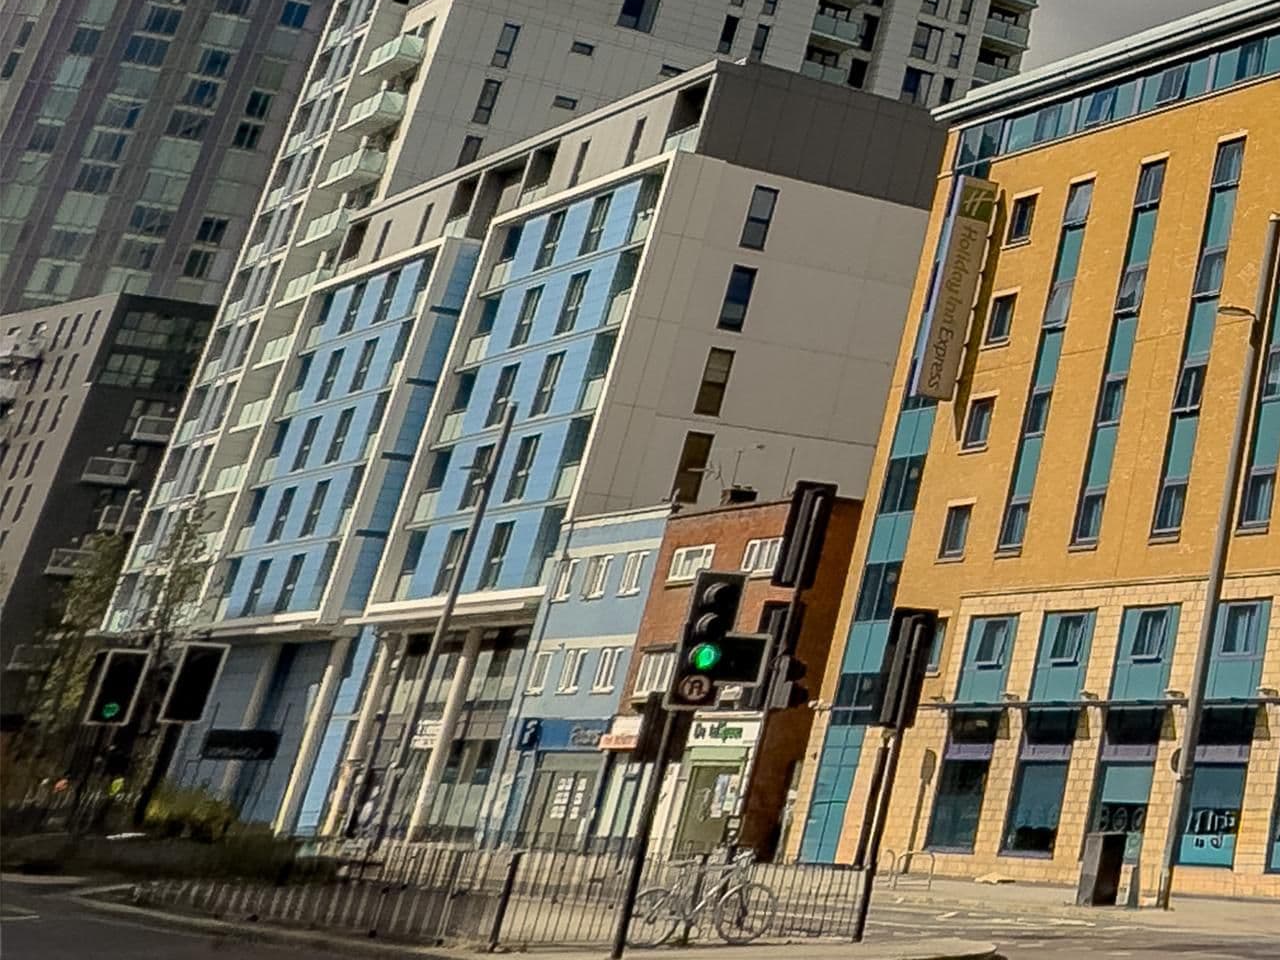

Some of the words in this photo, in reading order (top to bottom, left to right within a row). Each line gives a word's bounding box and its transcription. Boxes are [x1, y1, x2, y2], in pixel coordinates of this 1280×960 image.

[945, 225, 978, 294] Holiday
[943, 296, 963, 324] Inn
[927, 326, 954, 391] Express
